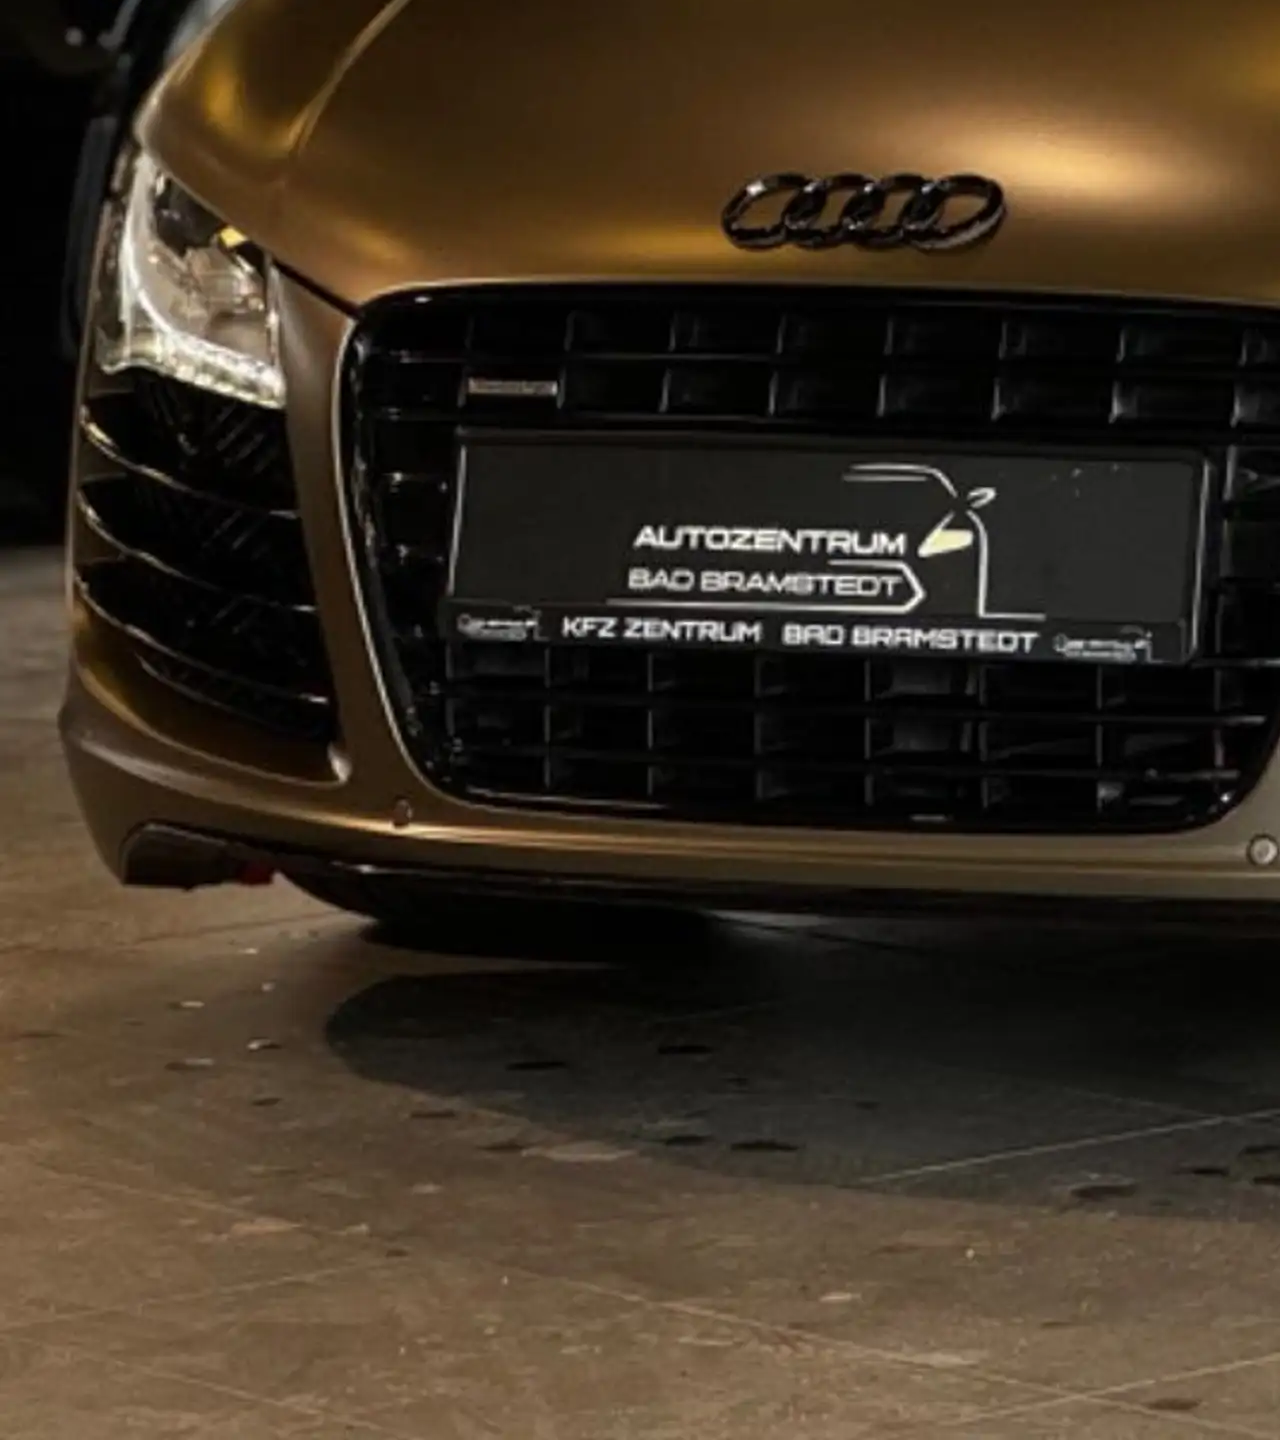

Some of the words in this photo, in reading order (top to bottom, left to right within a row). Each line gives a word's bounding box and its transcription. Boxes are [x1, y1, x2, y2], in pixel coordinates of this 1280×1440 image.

[633, 525, 908, 556] AUTOZENTRUM
[627, 567, 695, 592] BAD
[700, 570, 904, 597] BRAMSTEDT
[561, 616, 616, 639] KFZ
[623, 617, 762, 643] ZENTRUM
[782, 622, 845, 647] BAD
[852, 625, 1040, 654] BRAMSTEDT
